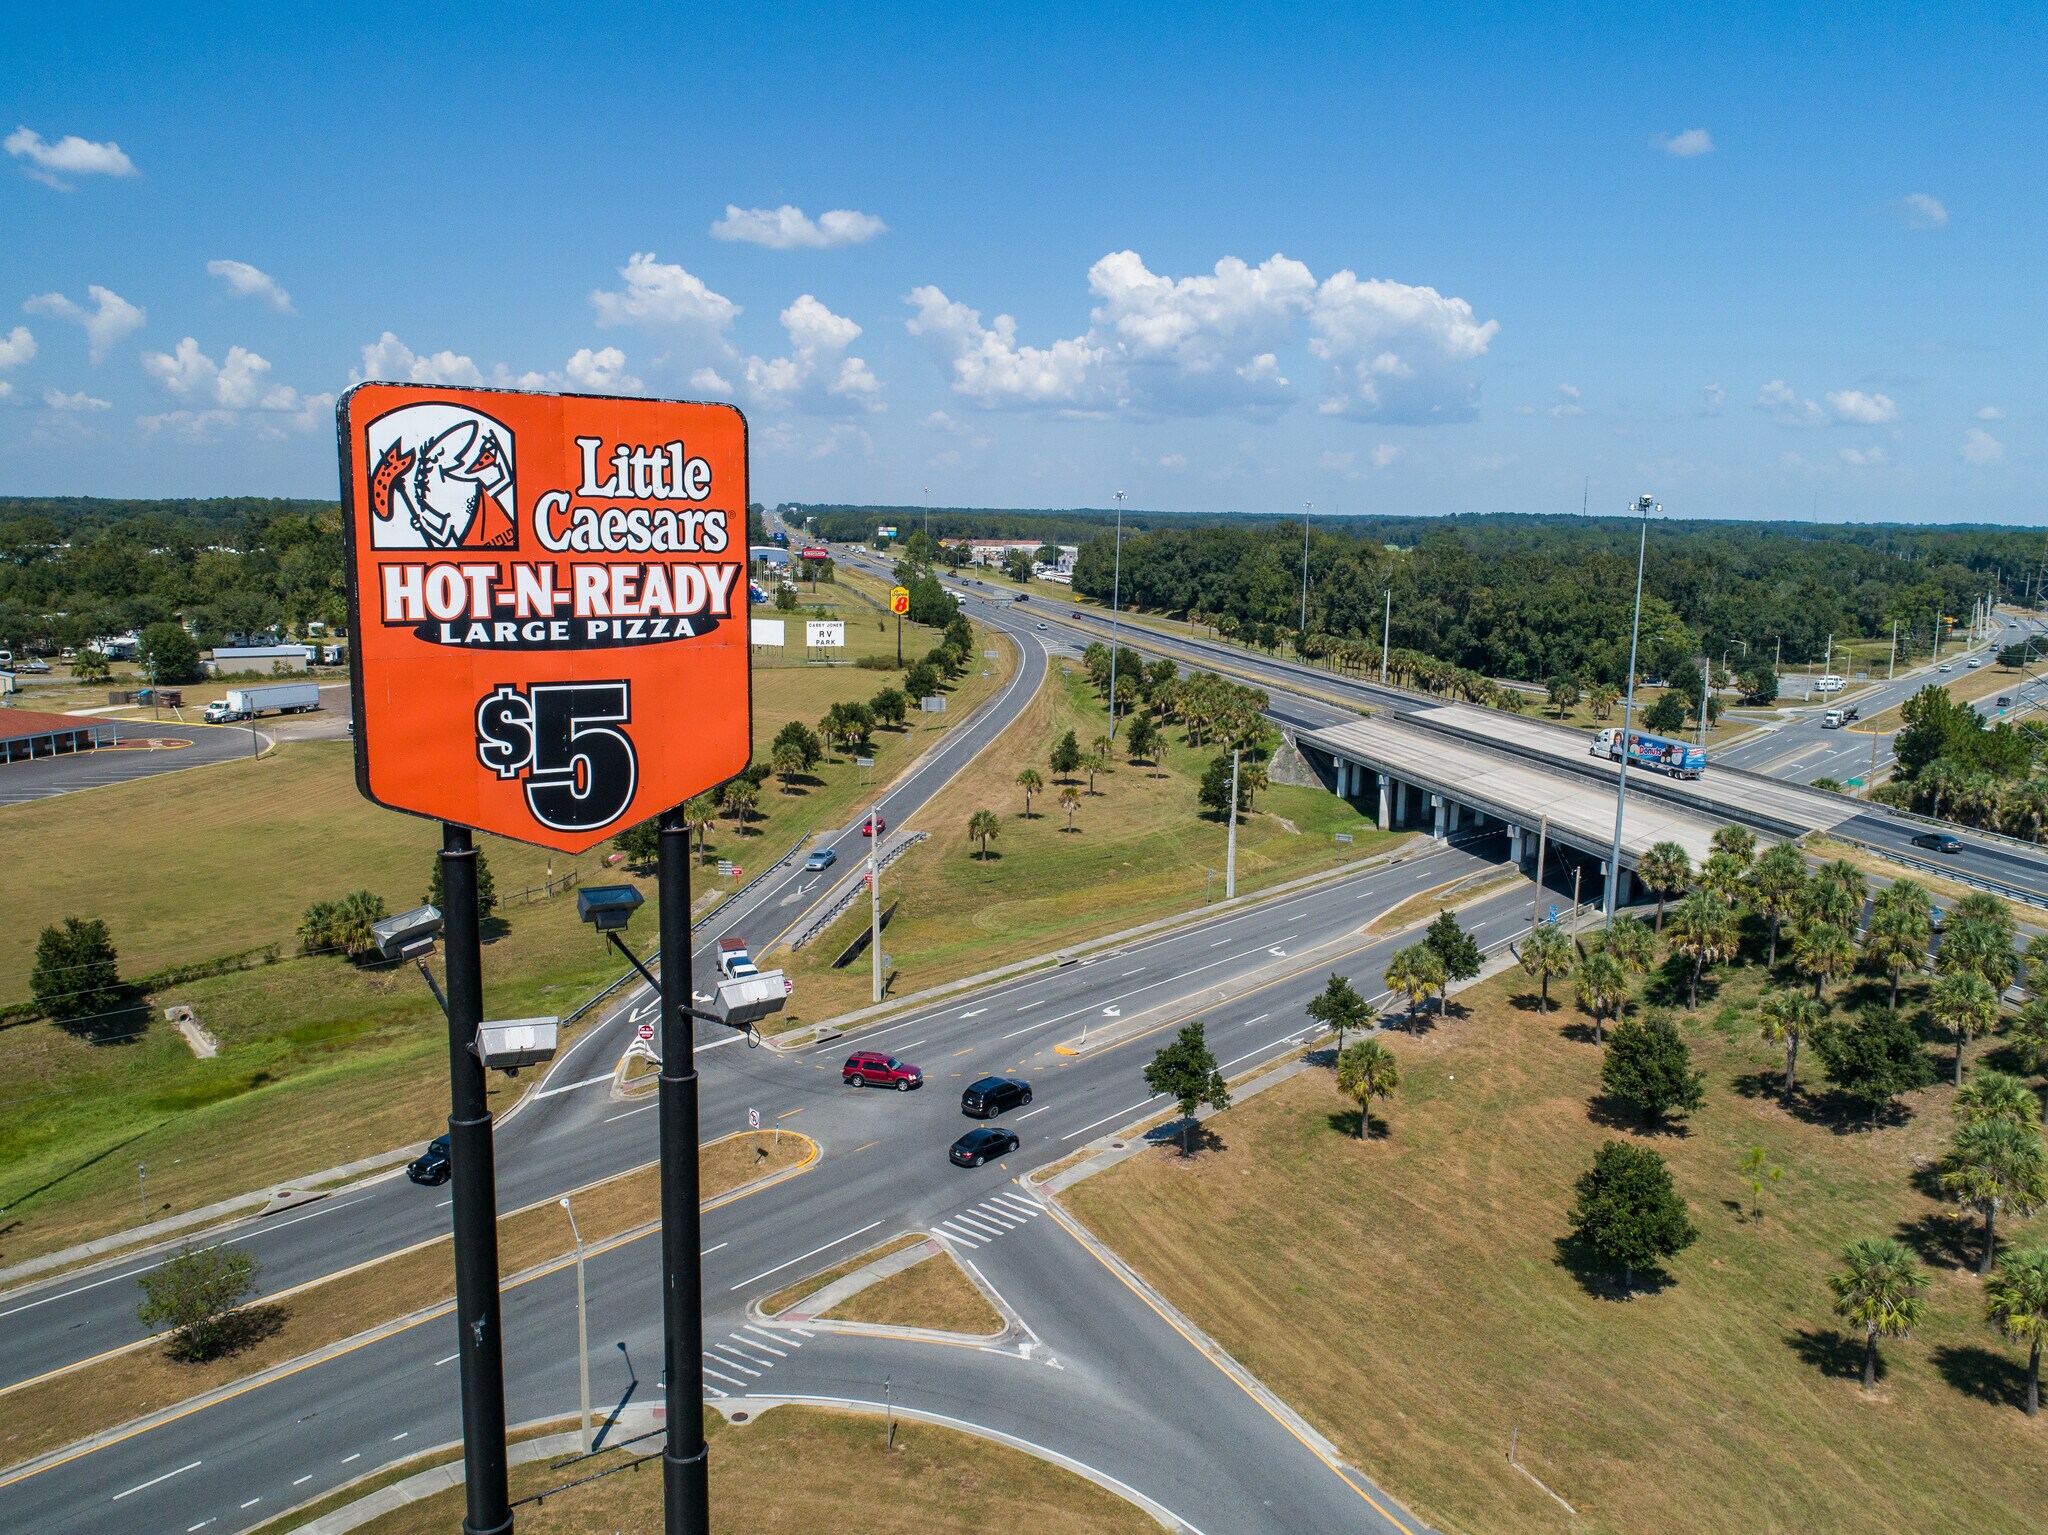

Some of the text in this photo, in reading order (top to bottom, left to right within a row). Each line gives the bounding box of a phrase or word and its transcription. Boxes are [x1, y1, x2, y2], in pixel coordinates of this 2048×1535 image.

[576, 437, 711, 500] Little
[533, 490, 728, 553] Caesars
[381, 563, 739, 622] HOT-N-READY
[895, 596, 908, 612] 8
[440, 619, 569, 644] LARGE
[587, 618, 696, 640] PIZZA
[475, 680, 638, 833] $5
[1639, 745, 1663, 757] Donuts
